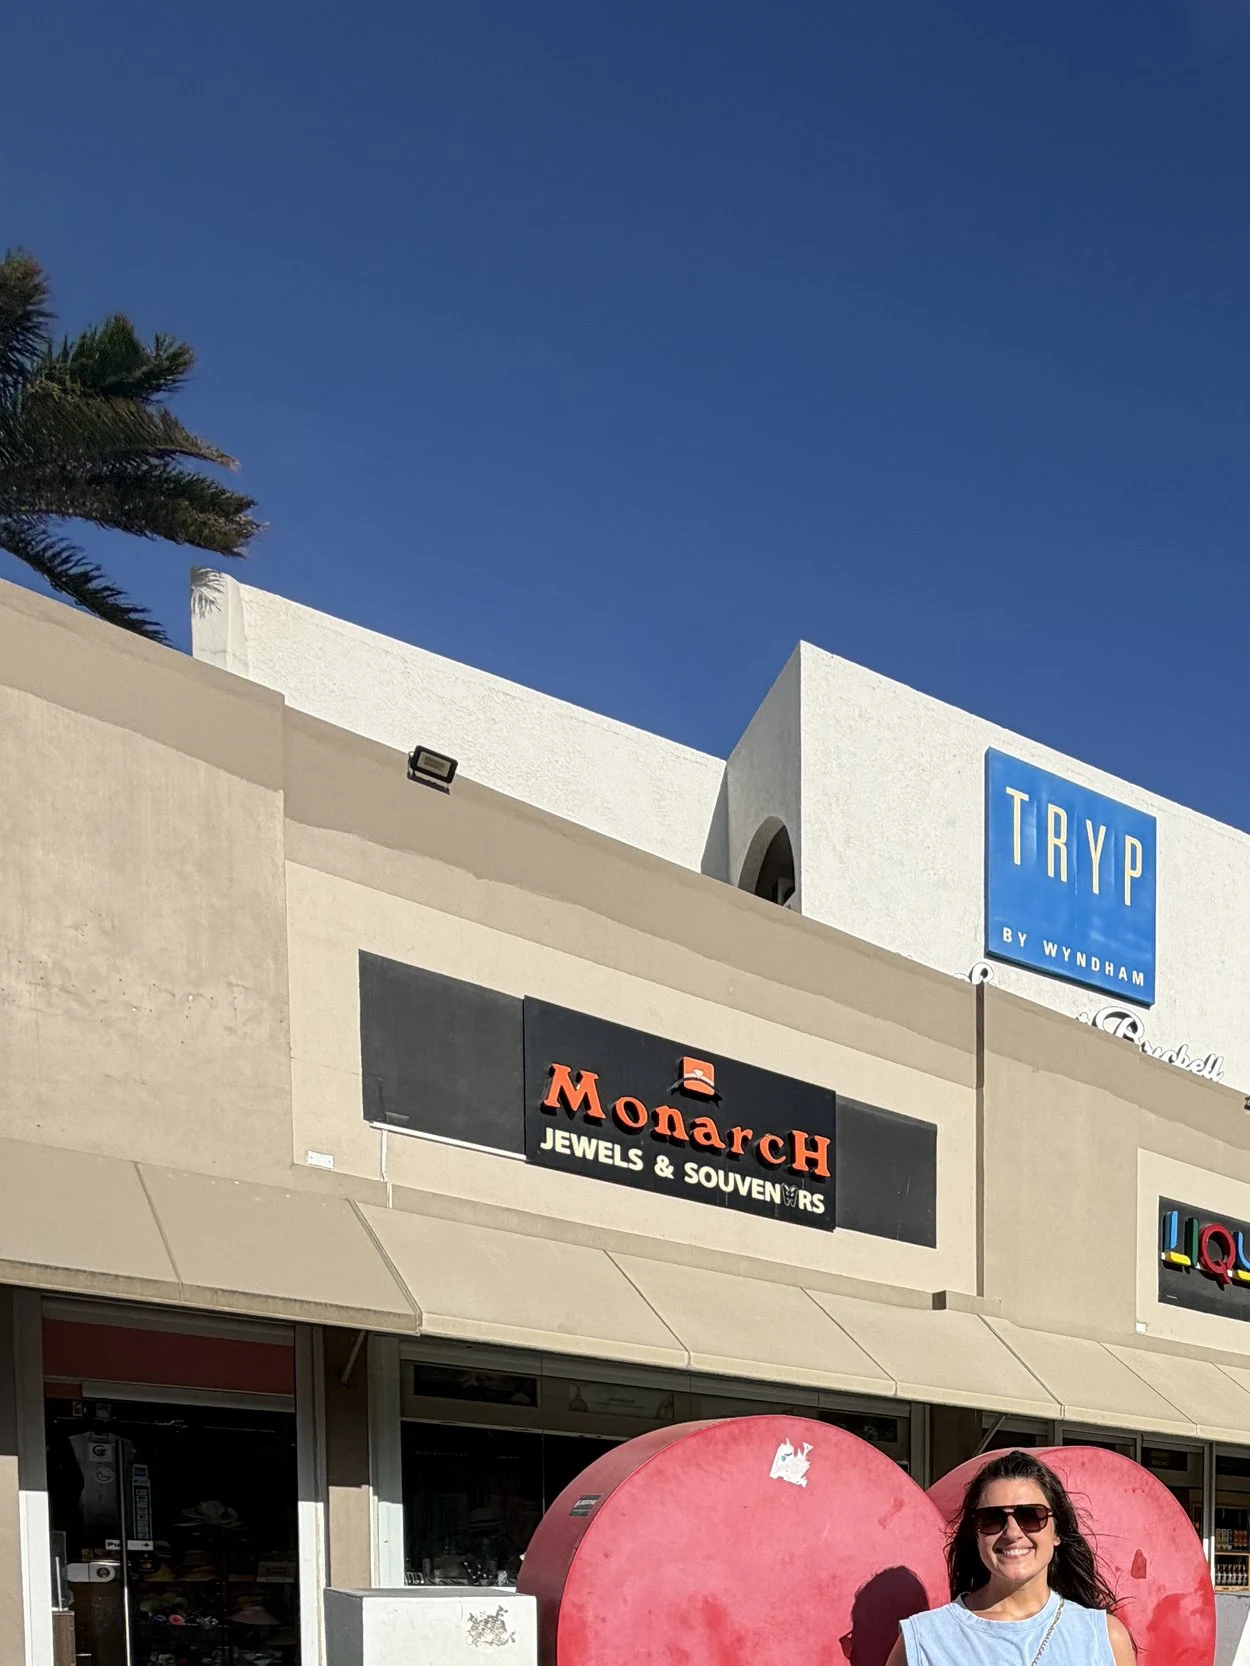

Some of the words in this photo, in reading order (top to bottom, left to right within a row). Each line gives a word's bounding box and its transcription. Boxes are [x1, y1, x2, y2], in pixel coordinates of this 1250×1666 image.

[1005, 786, 1143, 907] TRYP
[1002, 926, 1027, 948] BY
[1043, 940, 1145, 987] WYNDHAM
[540, 1127, 644, 1172] JEWELS
[654, 1155, 676, 1180] &
